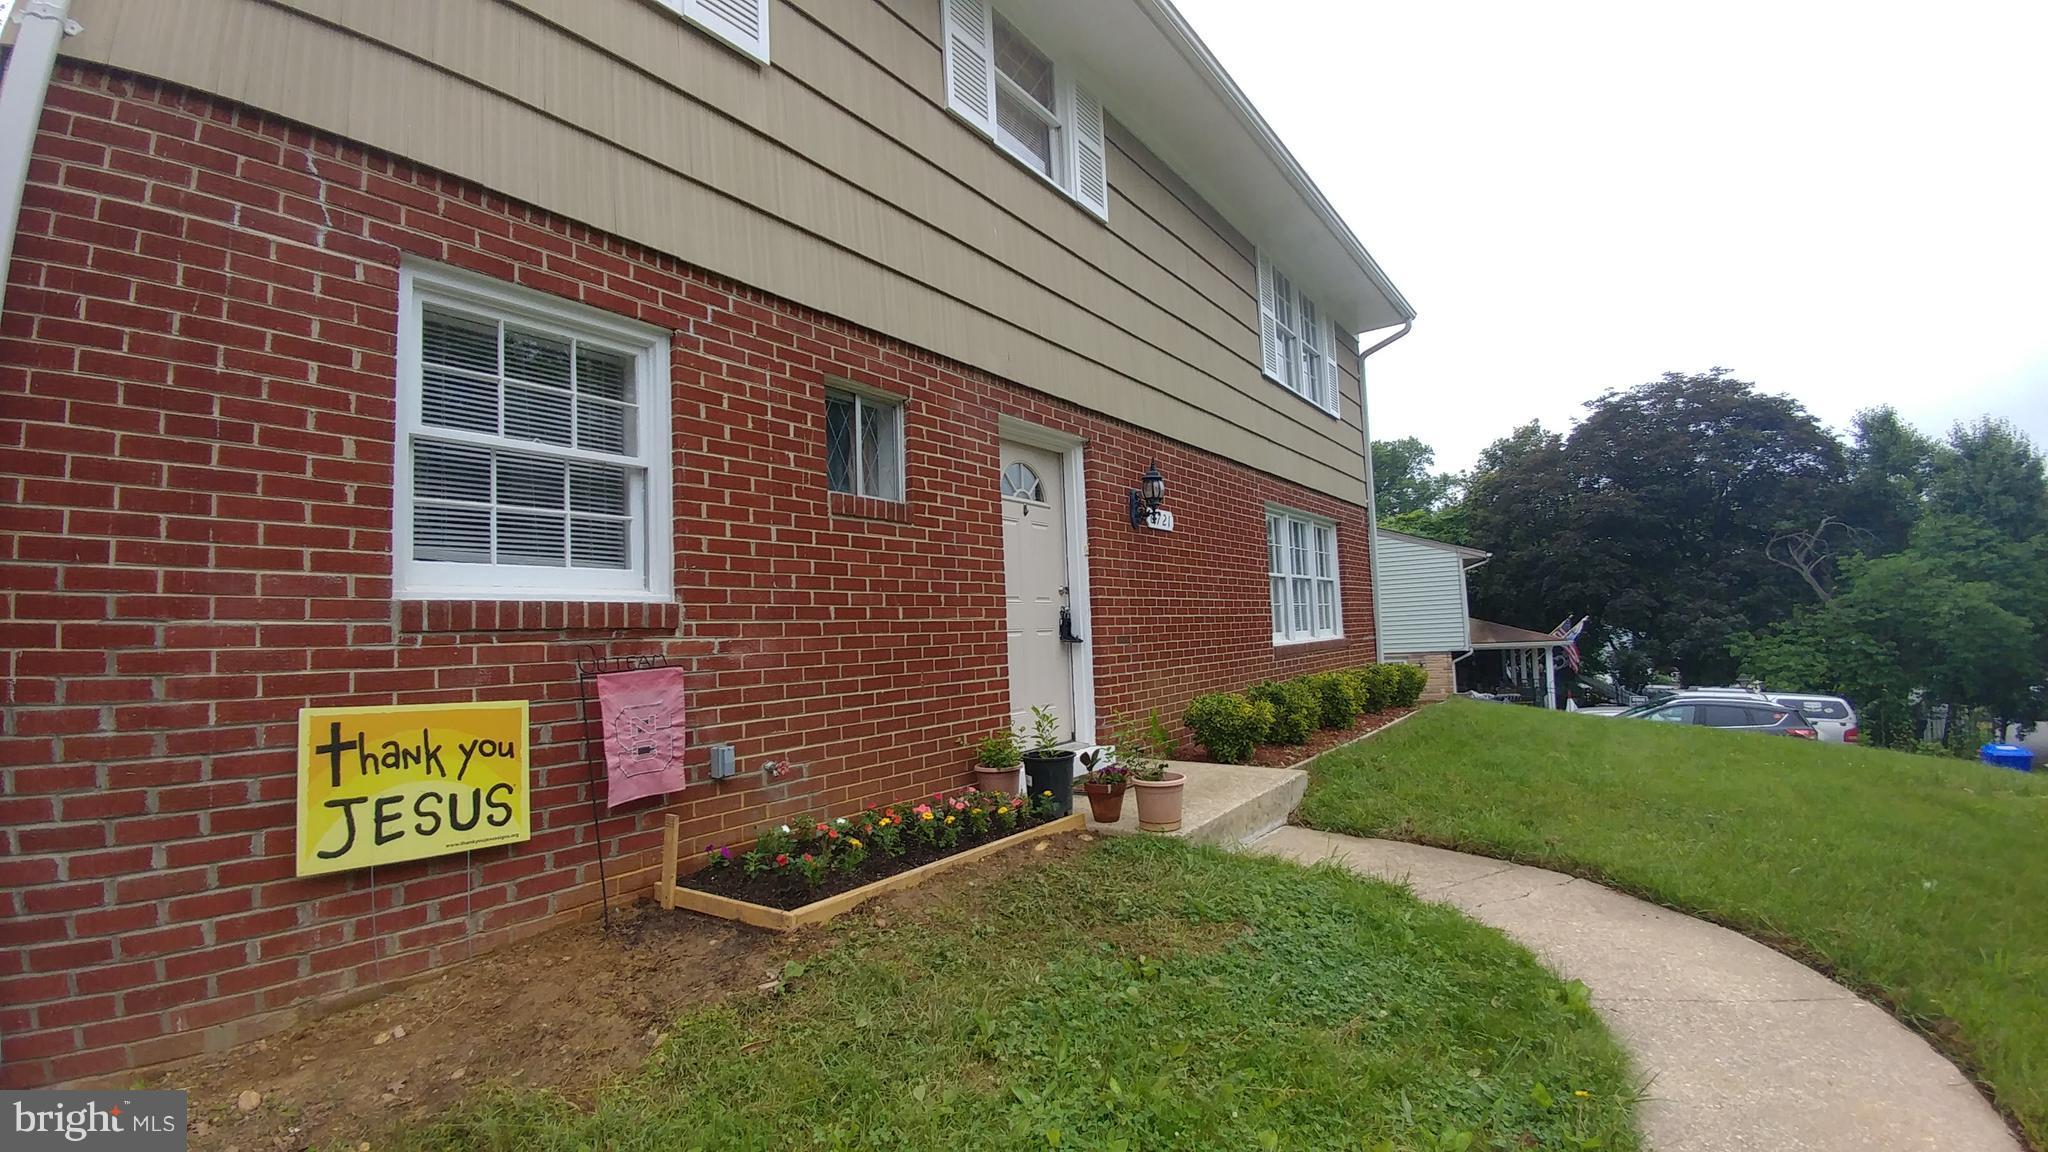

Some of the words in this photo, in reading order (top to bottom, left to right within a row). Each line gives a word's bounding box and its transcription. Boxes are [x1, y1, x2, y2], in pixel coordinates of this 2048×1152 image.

[607, 654, 668, 671] TEAM
[316, 722, 447, 787] thank
[458, 739, 515, 781] you
[317, 782, 514, 860] JESUS
